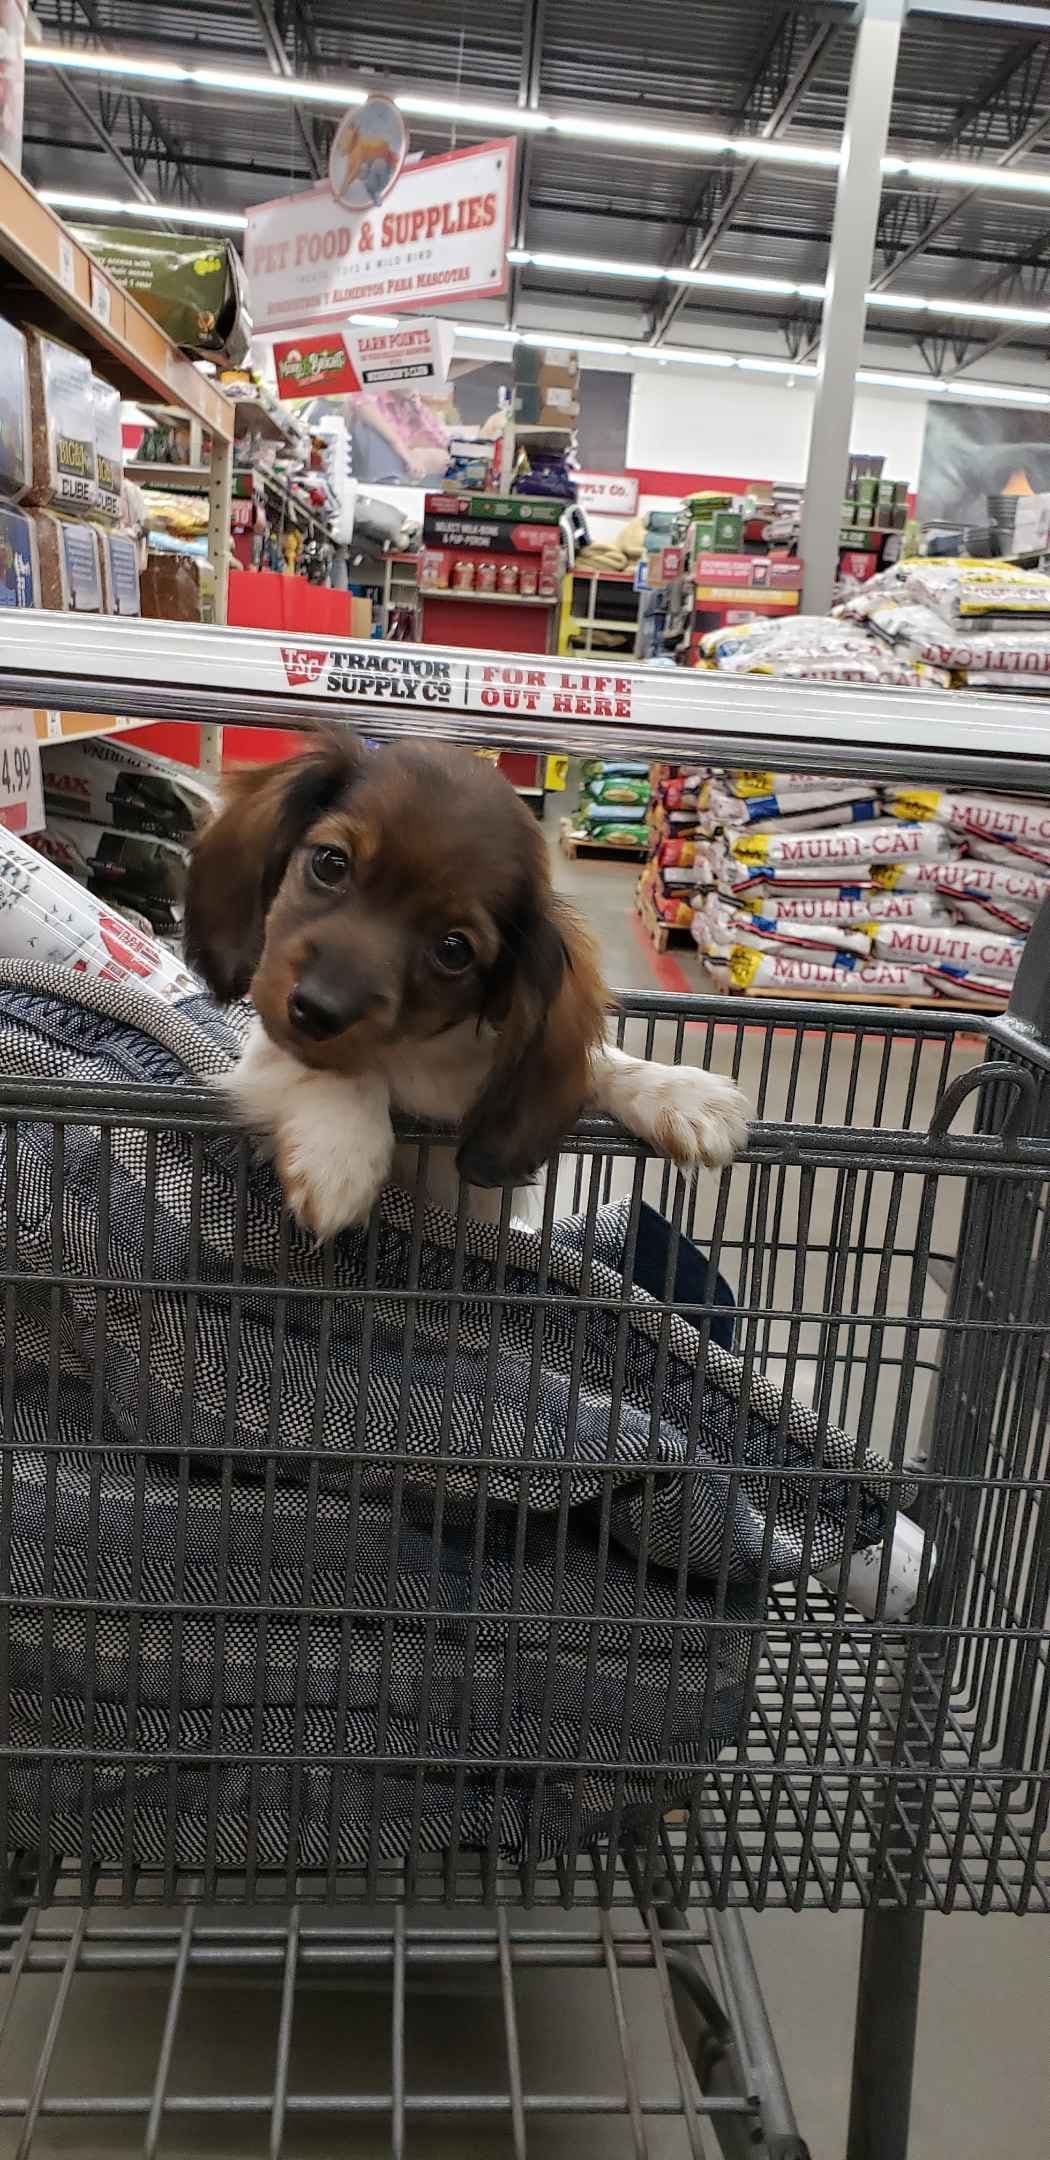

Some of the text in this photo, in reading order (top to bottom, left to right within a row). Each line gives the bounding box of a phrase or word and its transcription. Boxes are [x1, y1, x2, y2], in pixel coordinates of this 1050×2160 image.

[252, 240, 291, 275] PET
[295, 227, 351, 268] FOOD
[358, 222, 374, 252] &
[381, 193, 497, 249] SUPPLIES
[386, 276, 415, 295] PARA
[416, 266, 471, 289] MASCOTAS
[62, 478, 89, 501] CUBE
[329, 651, 451, 679] TRACTOR
[326, 671, 421, 700] SUPPLY
[481, 666, 632, 695] FOR LIFE
[480, 686, 632, 718] OUT HERE
[781, 831, 923, 861] MULTI-CAT
[776, 897, 916, 919] MULTI-CAT
[774, 956, 912, 985] MULTI-CAT
